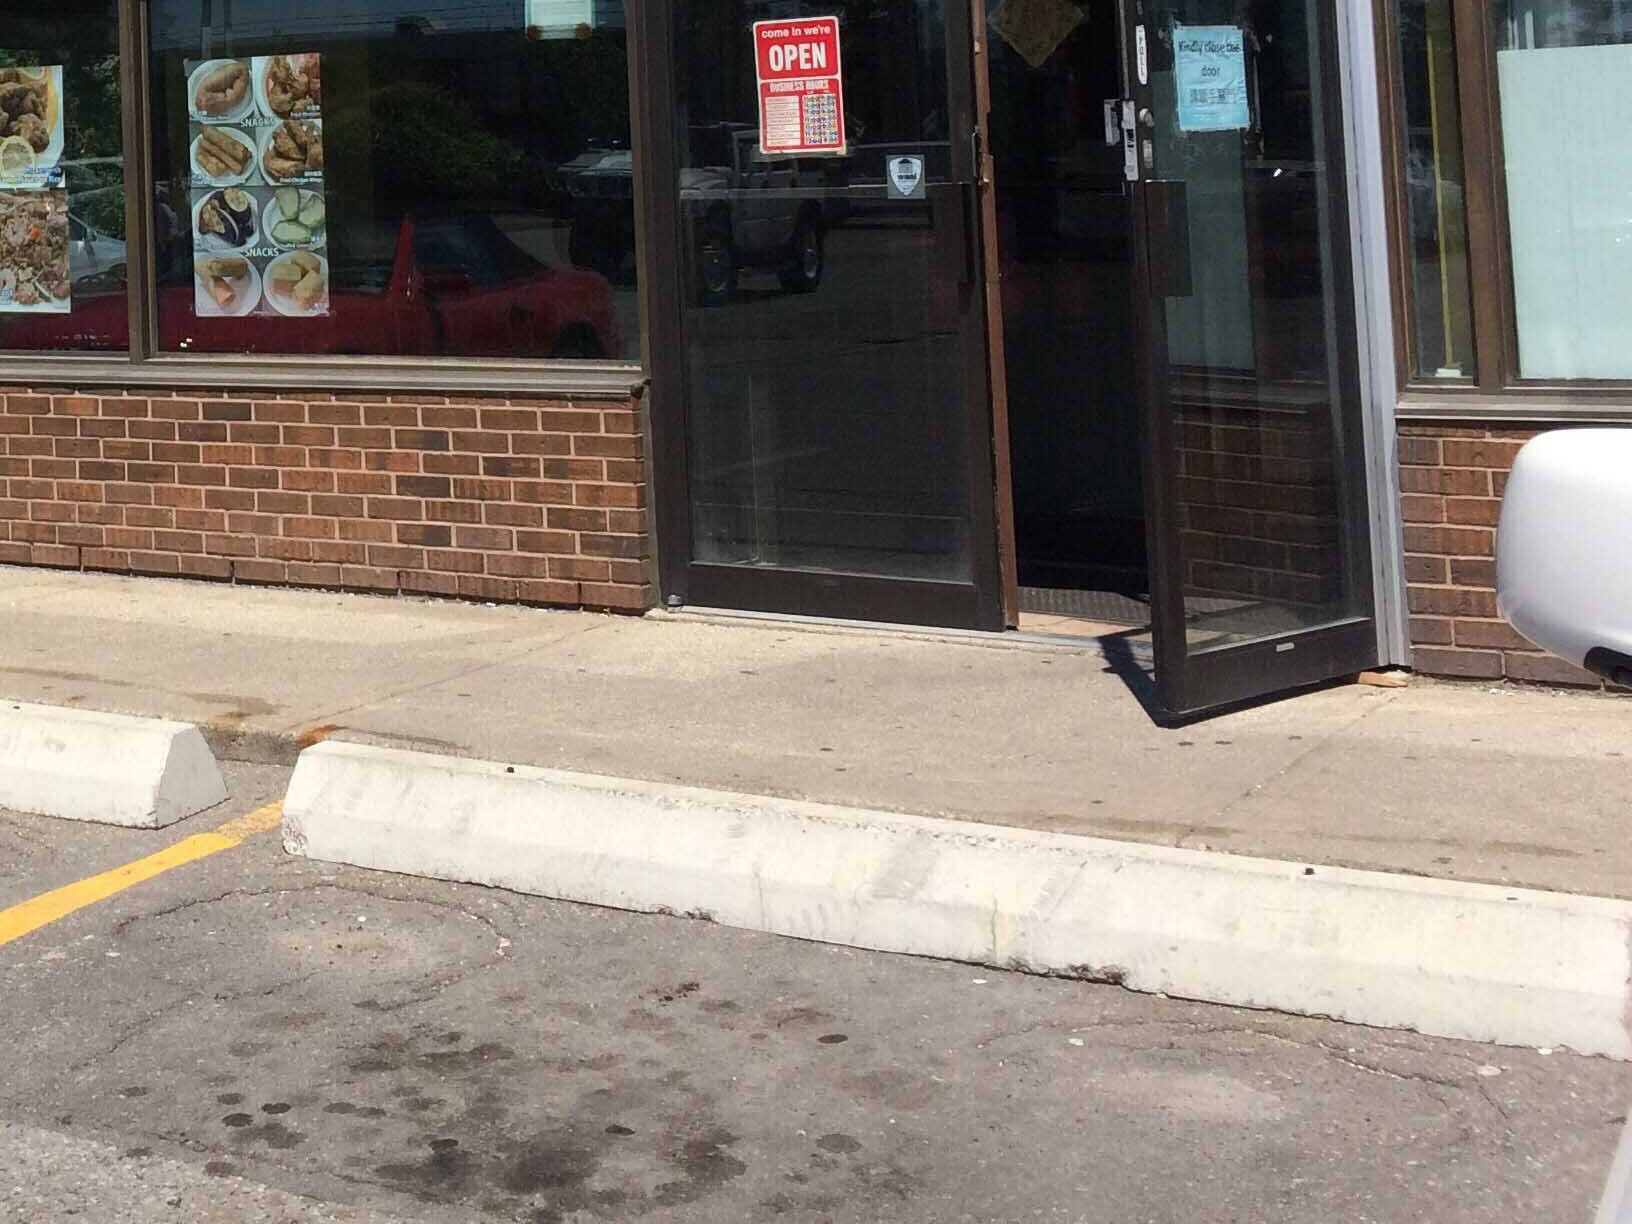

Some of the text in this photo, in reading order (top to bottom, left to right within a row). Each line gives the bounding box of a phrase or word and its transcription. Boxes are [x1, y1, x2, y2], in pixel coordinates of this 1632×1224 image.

[761, 28, 789, 39] come
[803, 24, 831, 35] we're
[1204, 41, 1225, 53] close
[768, 41, 828, 72] OPEN
[1201, 63, 1221, 77] door
[239, 117, 279, 128] SNACKS
[244, 247, 280, 258] SNACKS
